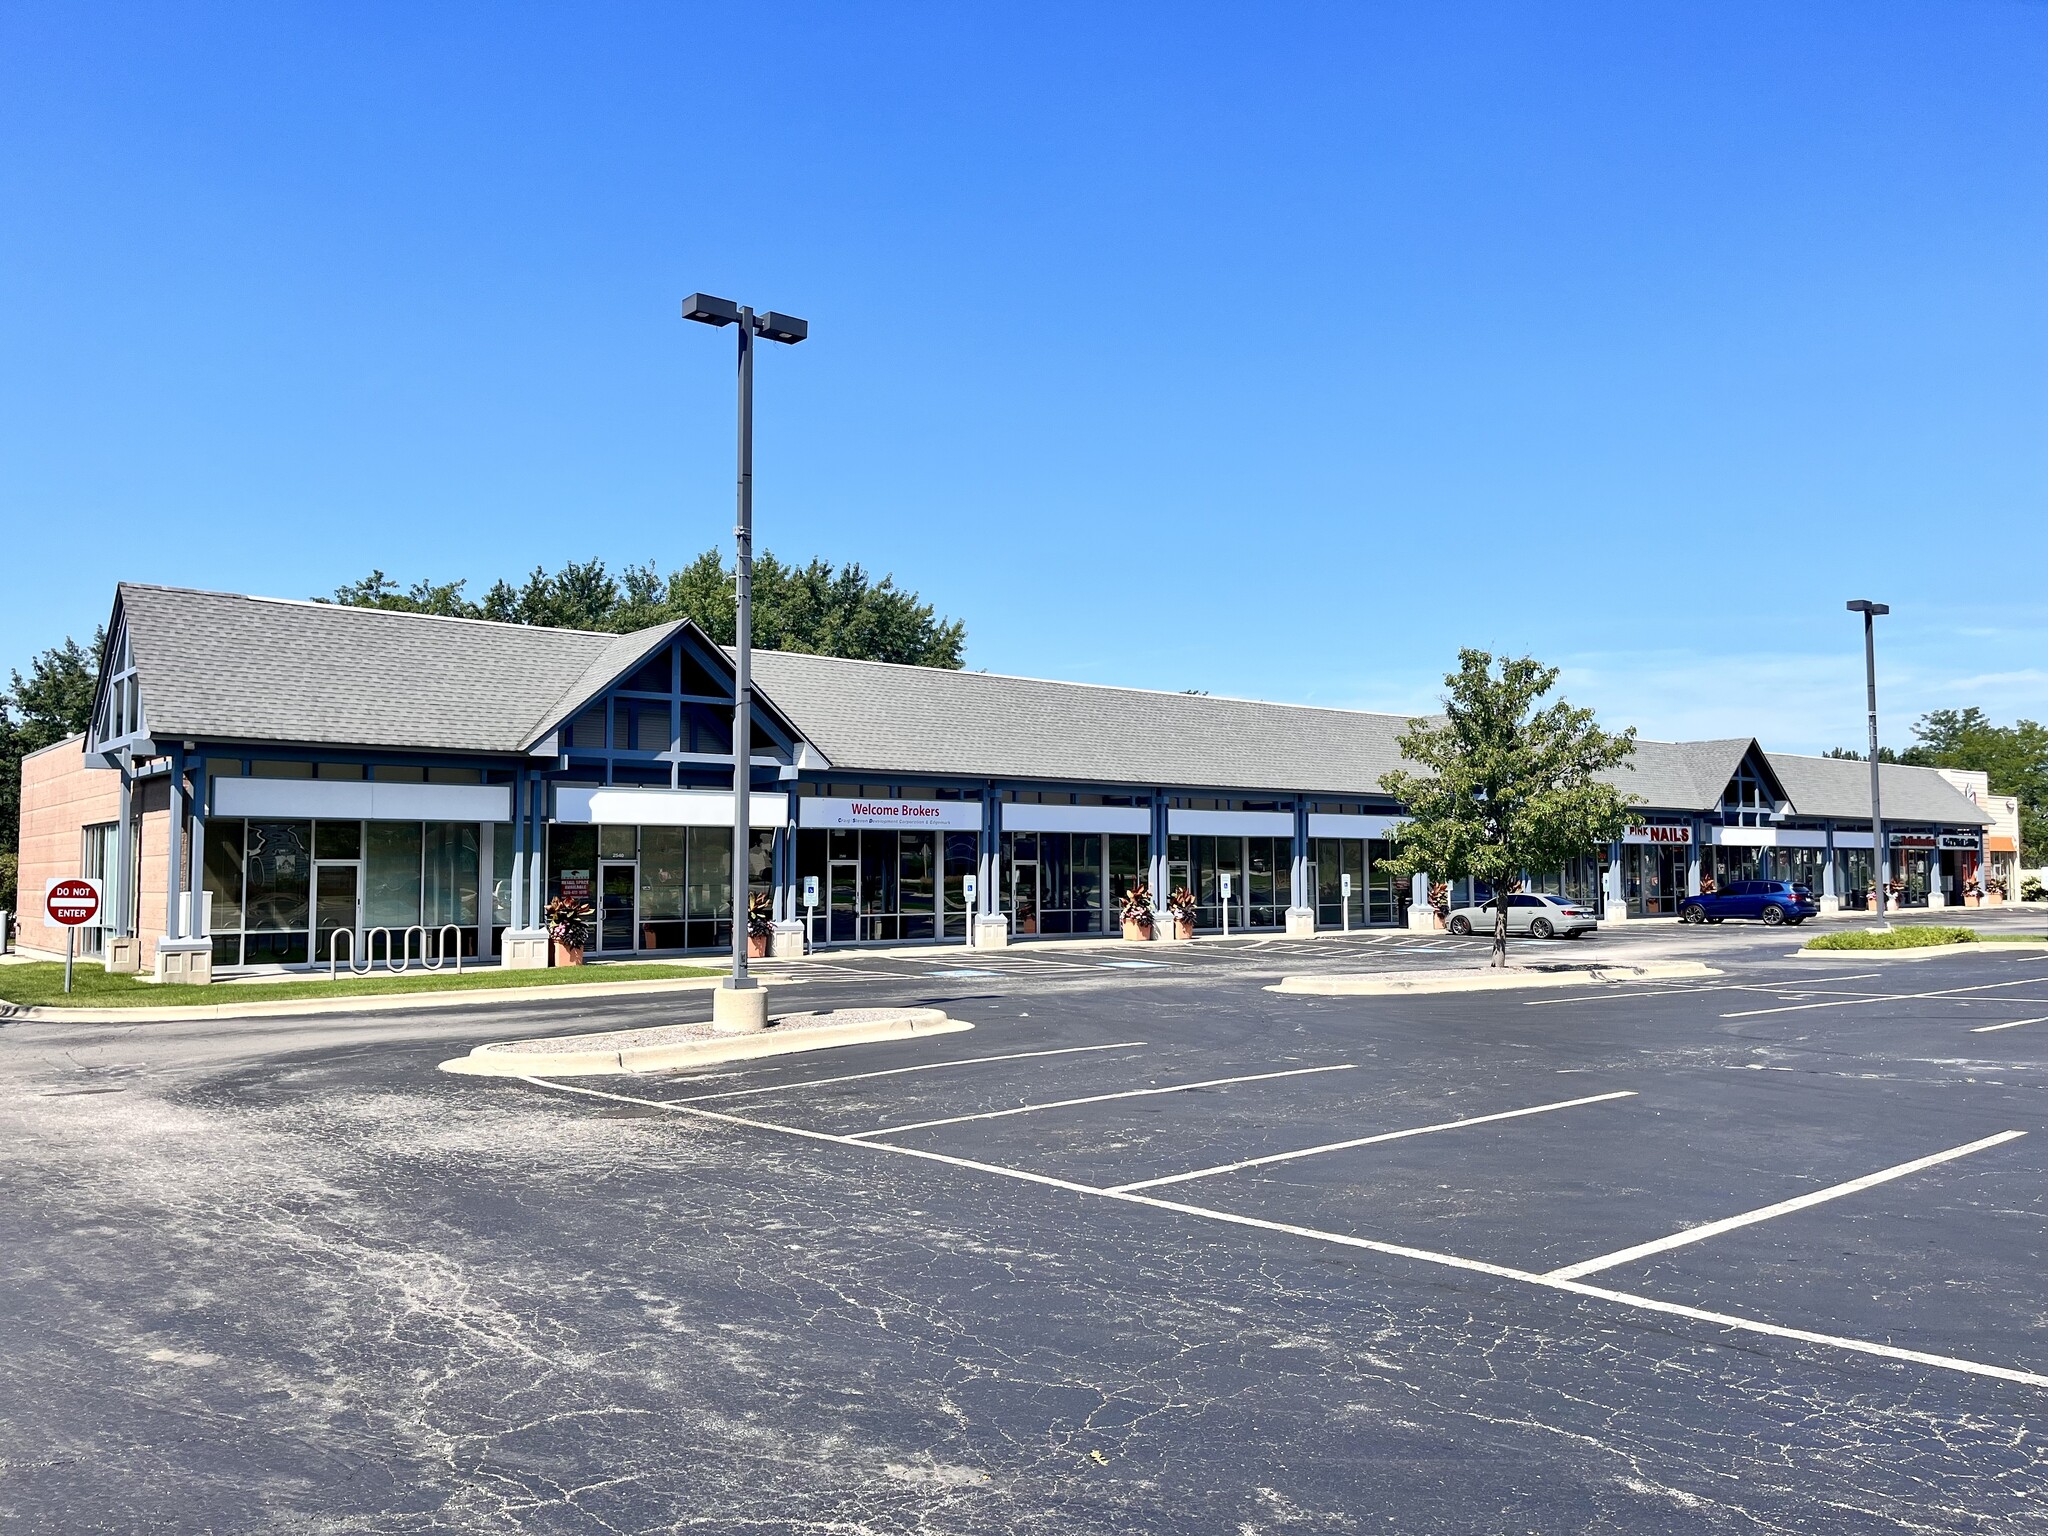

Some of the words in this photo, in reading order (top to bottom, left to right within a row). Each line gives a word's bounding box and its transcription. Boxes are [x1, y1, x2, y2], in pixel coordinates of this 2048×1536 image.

[852, 803, 899, 815] Welcome
[902, 804, 940, 817] Brokers
[1629, 826, 1649, 836] PINK
[1650, 827, 1689, 843] NAILS
[57, 888, 69, 896] DO
[73, 888, 90, 896] NOT
[58, 909, 86, 917] ENTER
